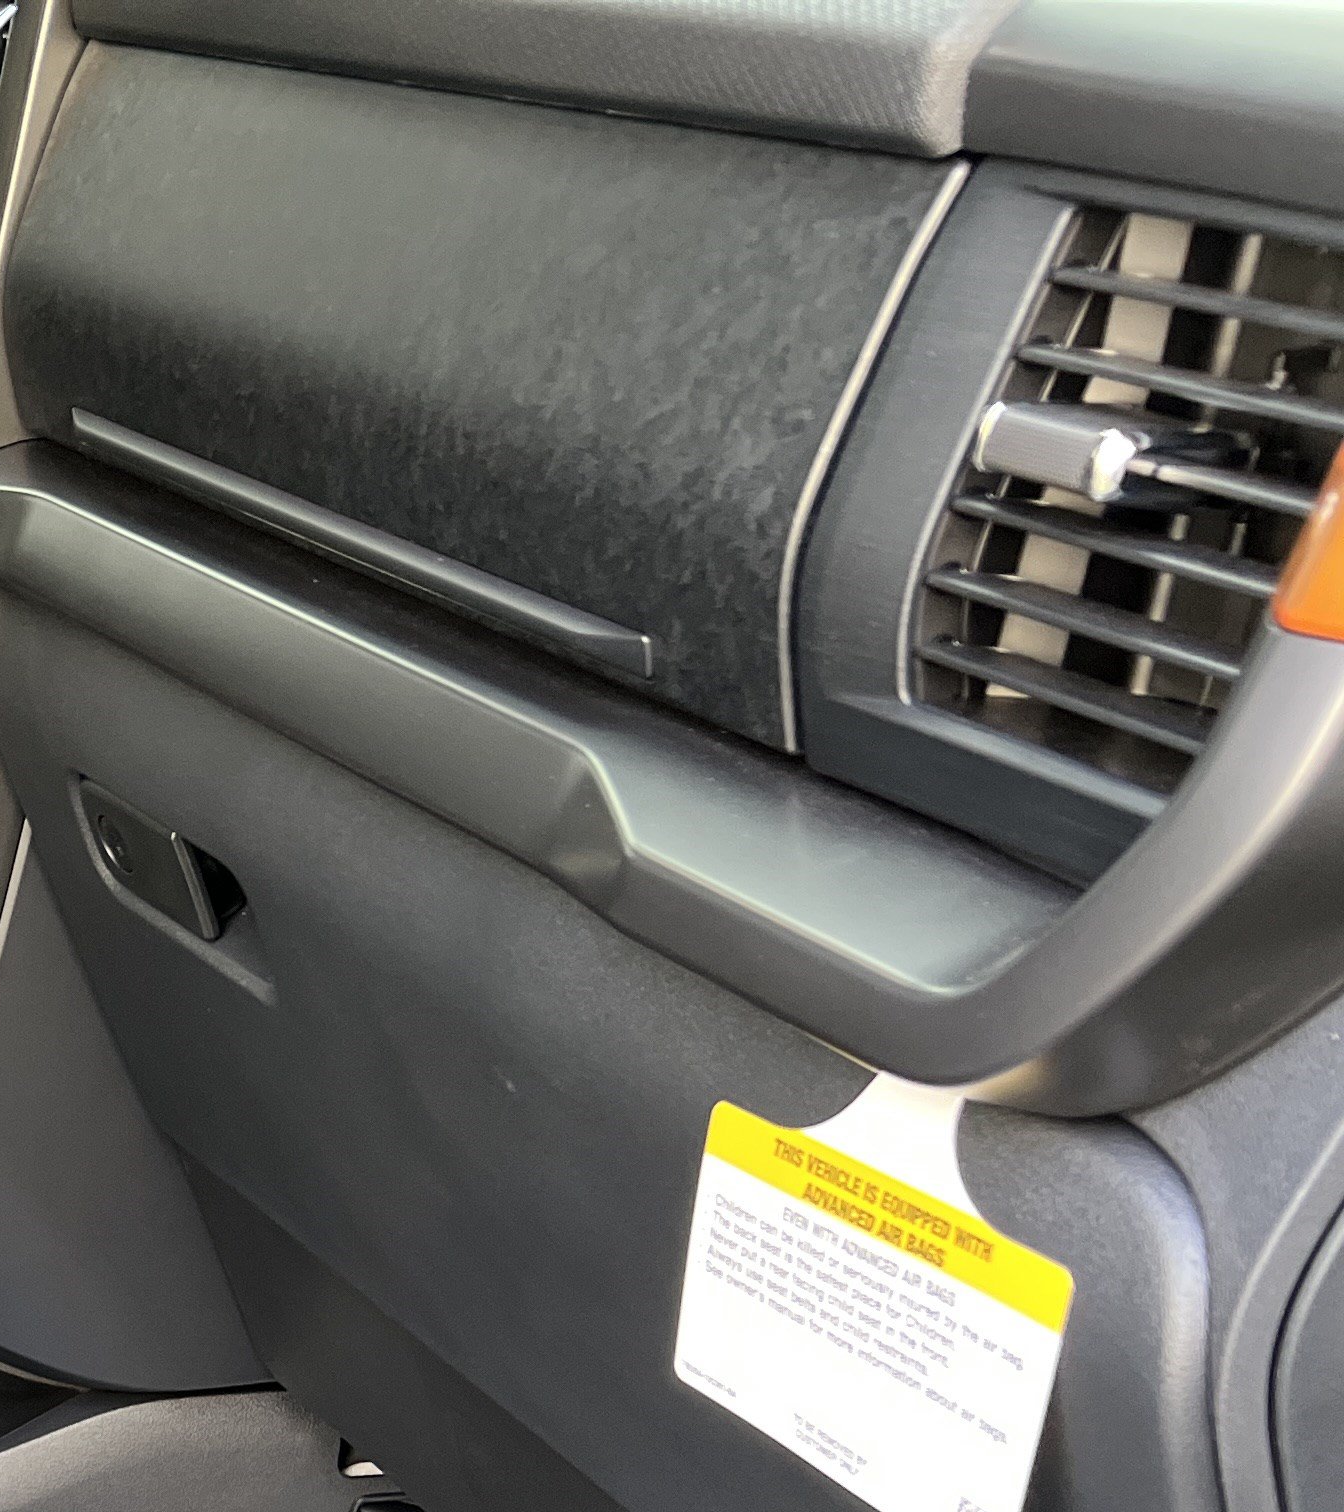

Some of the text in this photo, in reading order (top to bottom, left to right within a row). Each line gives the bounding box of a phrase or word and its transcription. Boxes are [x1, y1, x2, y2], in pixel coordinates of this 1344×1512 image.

[773, 1137, 994, 1263] THIS VEHICLE IS EQUIPPED WITH
[801, 1182, 946, 1268] ADVANCED AIR BAGS
[782, 1206, 956, 1308] EVEN WITH ADVANCED AIR BAGS
